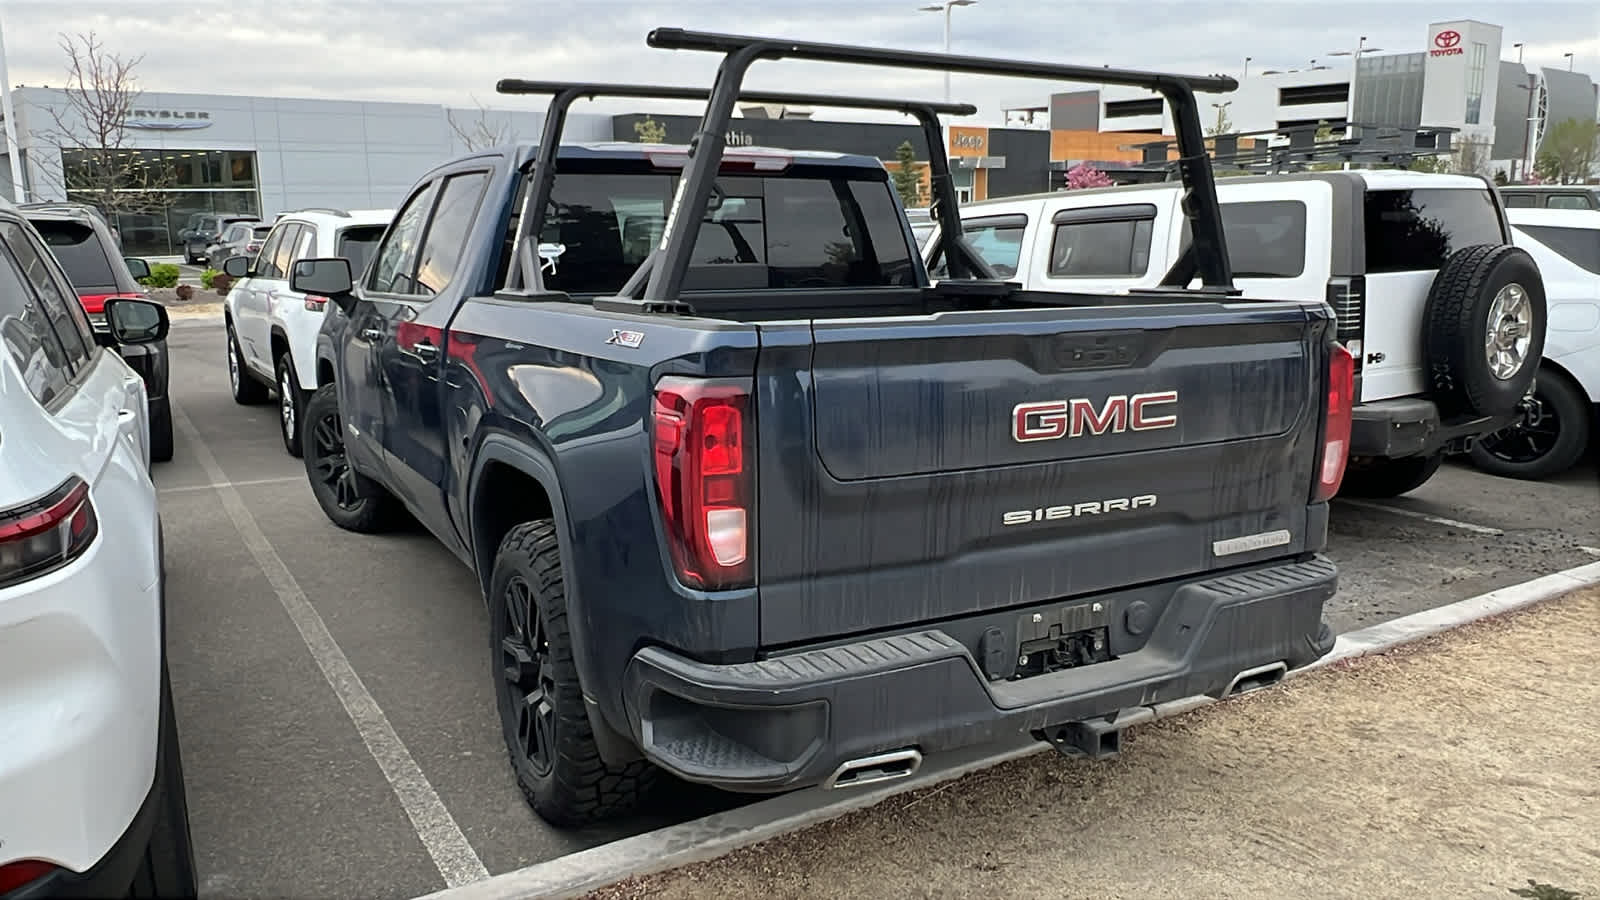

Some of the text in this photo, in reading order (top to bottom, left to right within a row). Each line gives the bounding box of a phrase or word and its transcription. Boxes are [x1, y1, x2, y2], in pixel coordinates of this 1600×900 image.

[1430, 48, 1464, 56] TOYOTA
[113, 109, 209, 119] HRYSLER
[724, 131, 753, 145] thia
[1012, 390, 1178, 443] GMC
[1003, 494, 1158, 525] SIERRA
